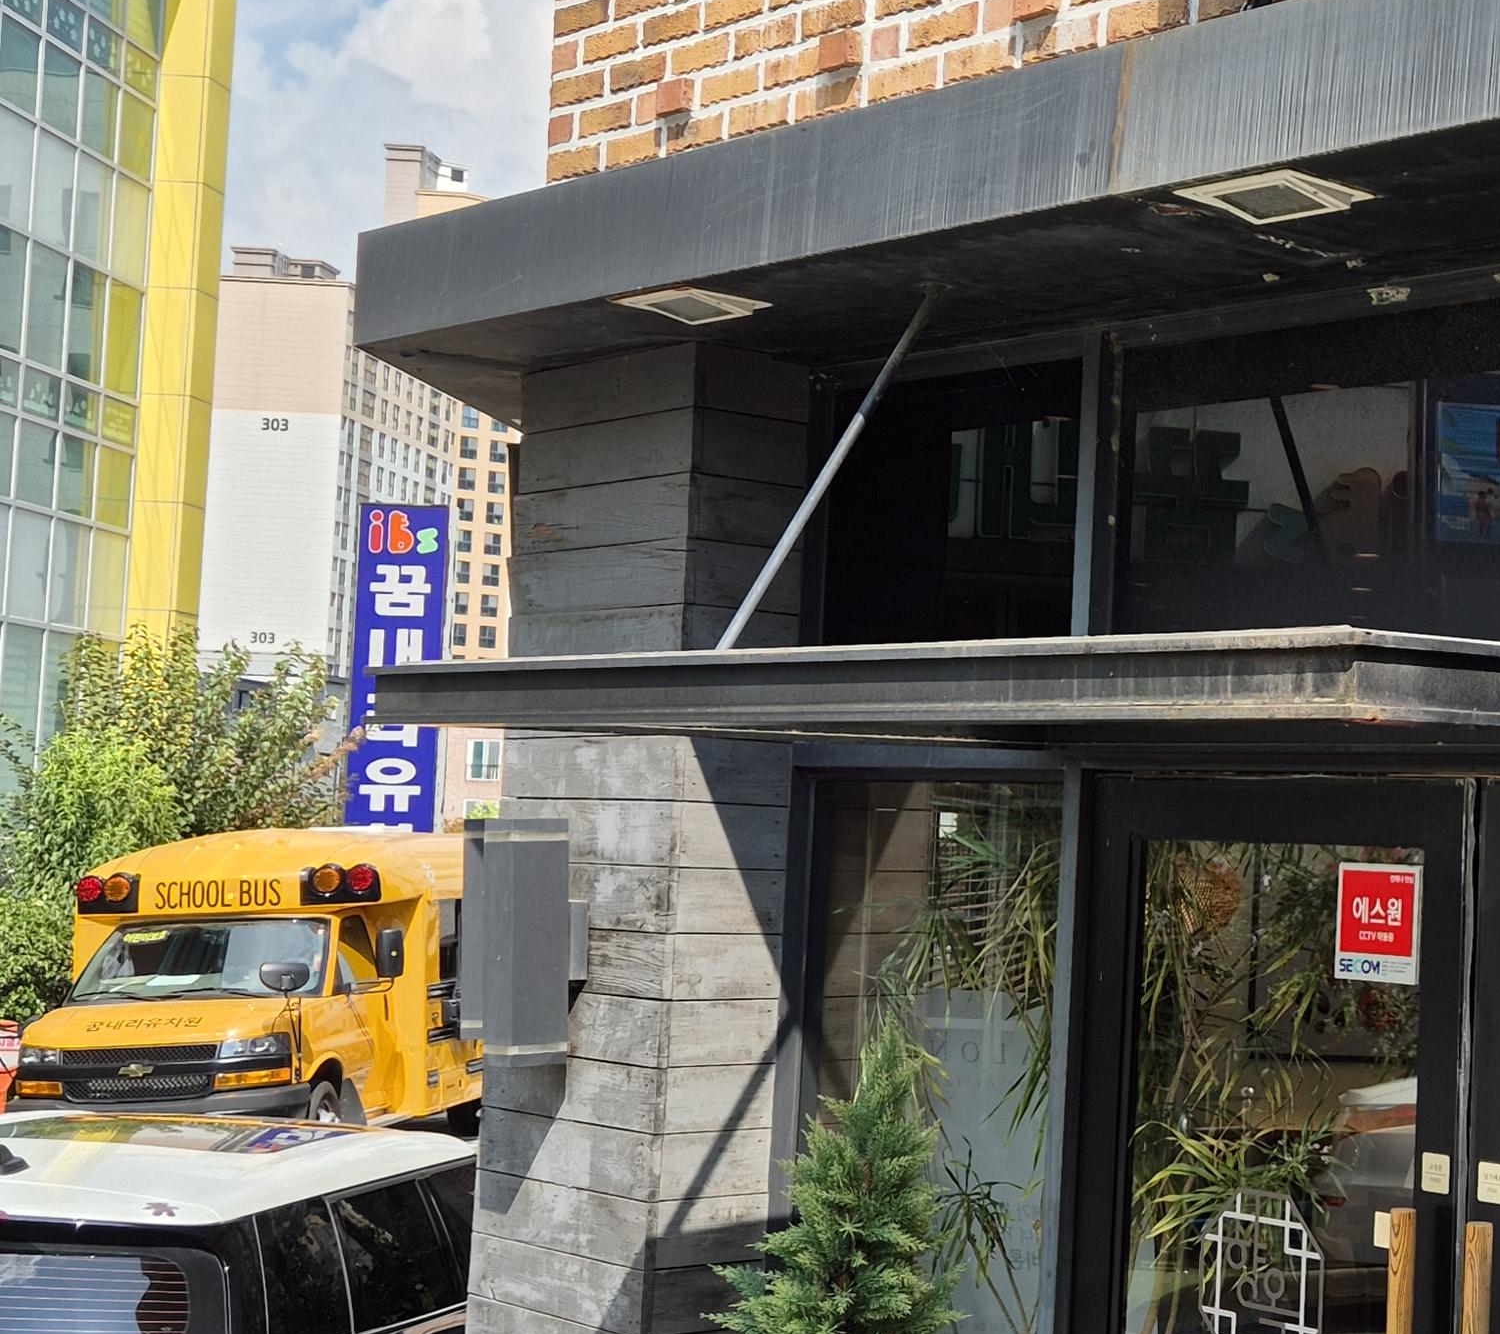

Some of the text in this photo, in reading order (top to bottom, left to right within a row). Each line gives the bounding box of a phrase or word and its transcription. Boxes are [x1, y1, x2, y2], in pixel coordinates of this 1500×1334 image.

[261, 417, 290, 431] 303
[251, 632, 276, 644] 303
[155, 878, 281, 910] SCHOOL BUS
[1352, 896, 1403, 927] 에스원
[1358, 930, 1376, 941] CCTV
[1338, 958, 1381, 975] SECOM
